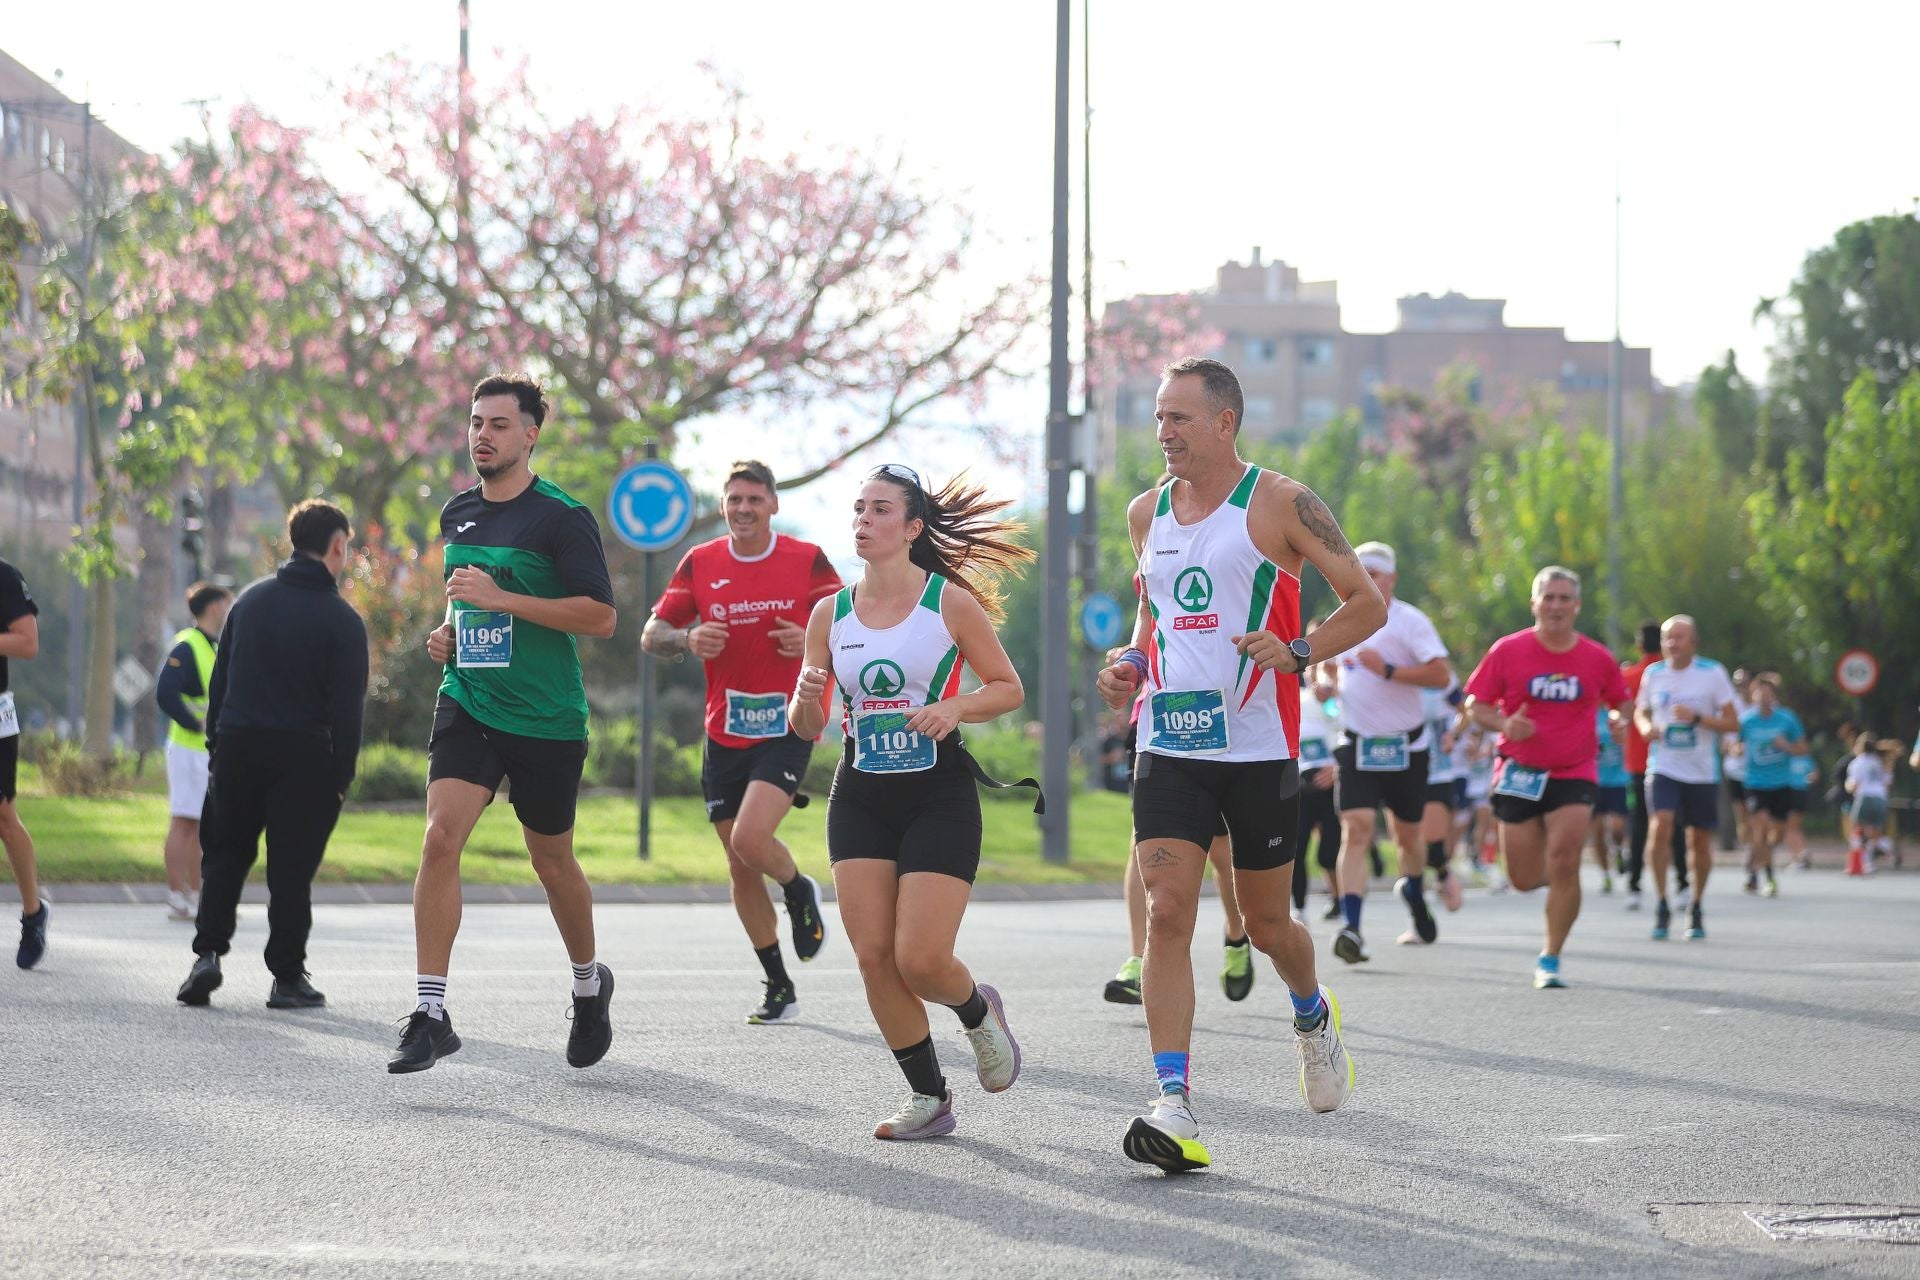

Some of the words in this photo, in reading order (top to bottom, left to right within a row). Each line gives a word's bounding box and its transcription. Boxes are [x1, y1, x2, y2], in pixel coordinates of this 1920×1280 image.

[729, 599, 796, 614] setcomur
[1175, 616, 1217, 628] SPAR
[462, 627, 503, 645] 1196
[865, 702, 908, 710] SPAR
[737, 707, 778, 722] 1069
[1162, 709, 1213, 730] 1098
[868, 731, 919, 751] 1101
